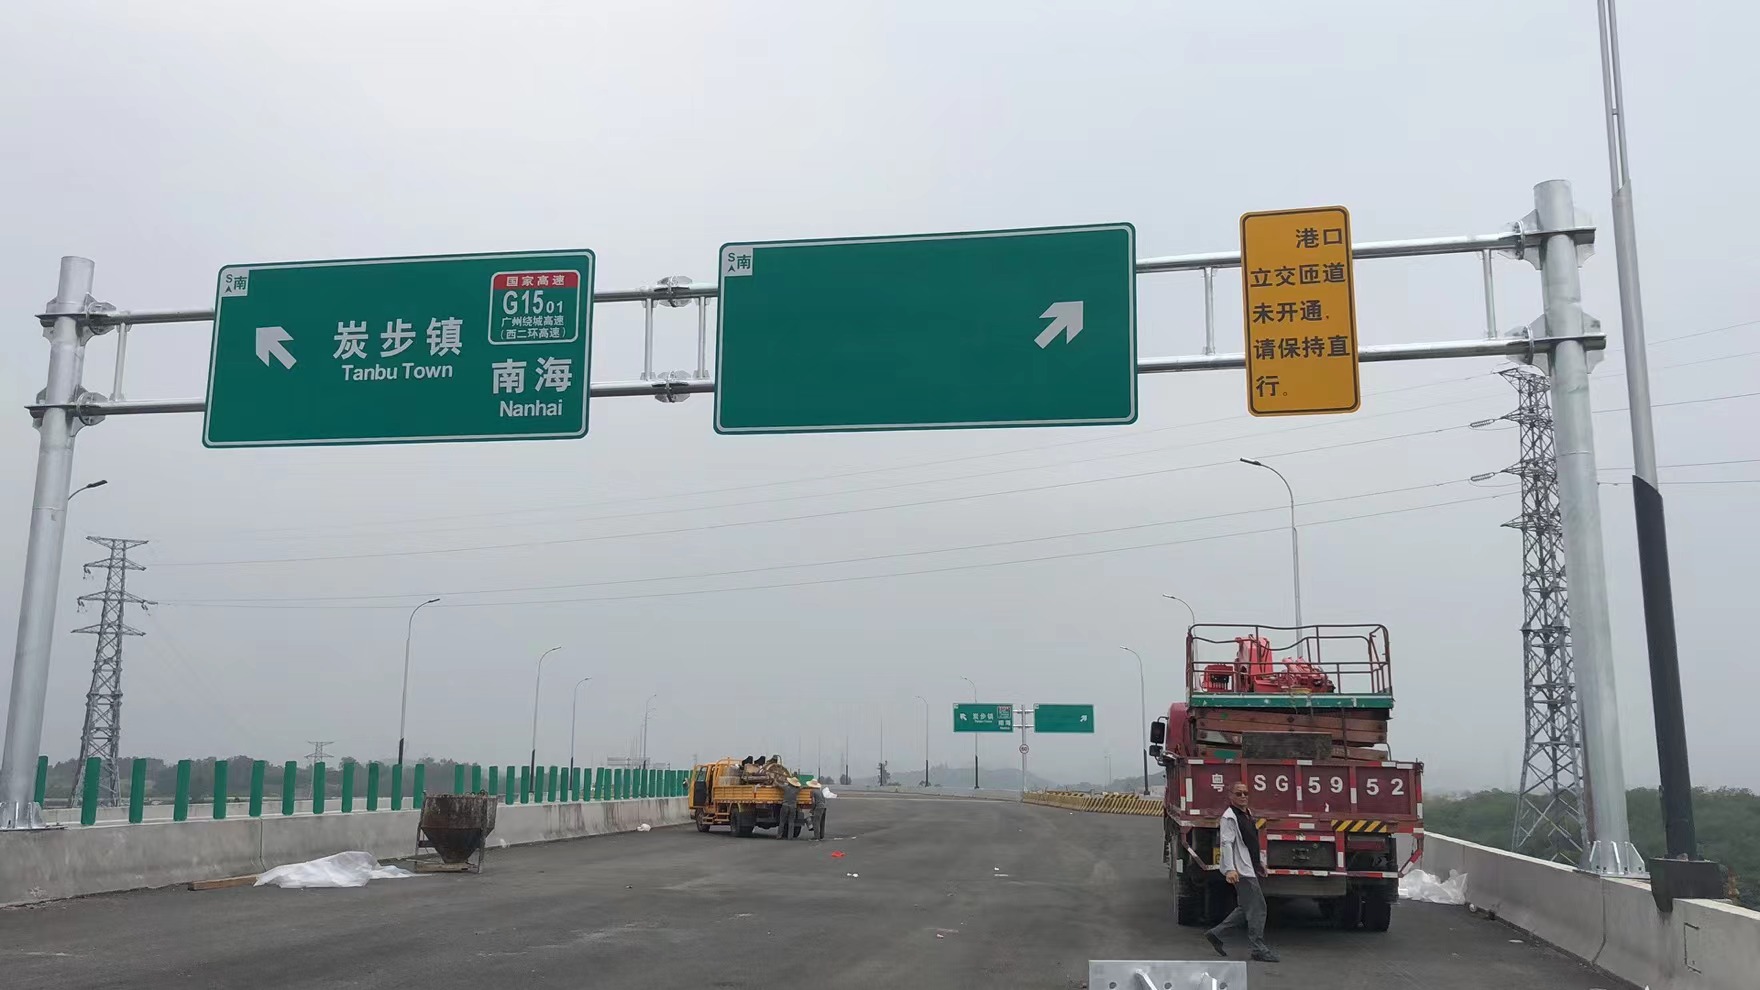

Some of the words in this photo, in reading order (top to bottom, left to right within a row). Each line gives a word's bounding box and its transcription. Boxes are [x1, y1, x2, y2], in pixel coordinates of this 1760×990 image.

[1295, 227, 1344, 249] 港口
[728, 252, 736, 263] S
[737, 254, 751, 270] 南
[225, 273, 233, 284] S
[233, 275, 248, 291] 南
[506, 274, 566, 288] 国家高速
[1250, 262, 1346, 288] 立交匝道
[501, 315, 564, 327] 广州绕城高速
[333, 316, 464, 360] 炭步镇
[1253, 335, 1350, 360] 请保持直
[341, 364, 398, 381] Tanbu
[400, 362, 454, 379] Town
[491, 356, 573, 394] 南海
[499, 399, 563, 417] Nanhai
